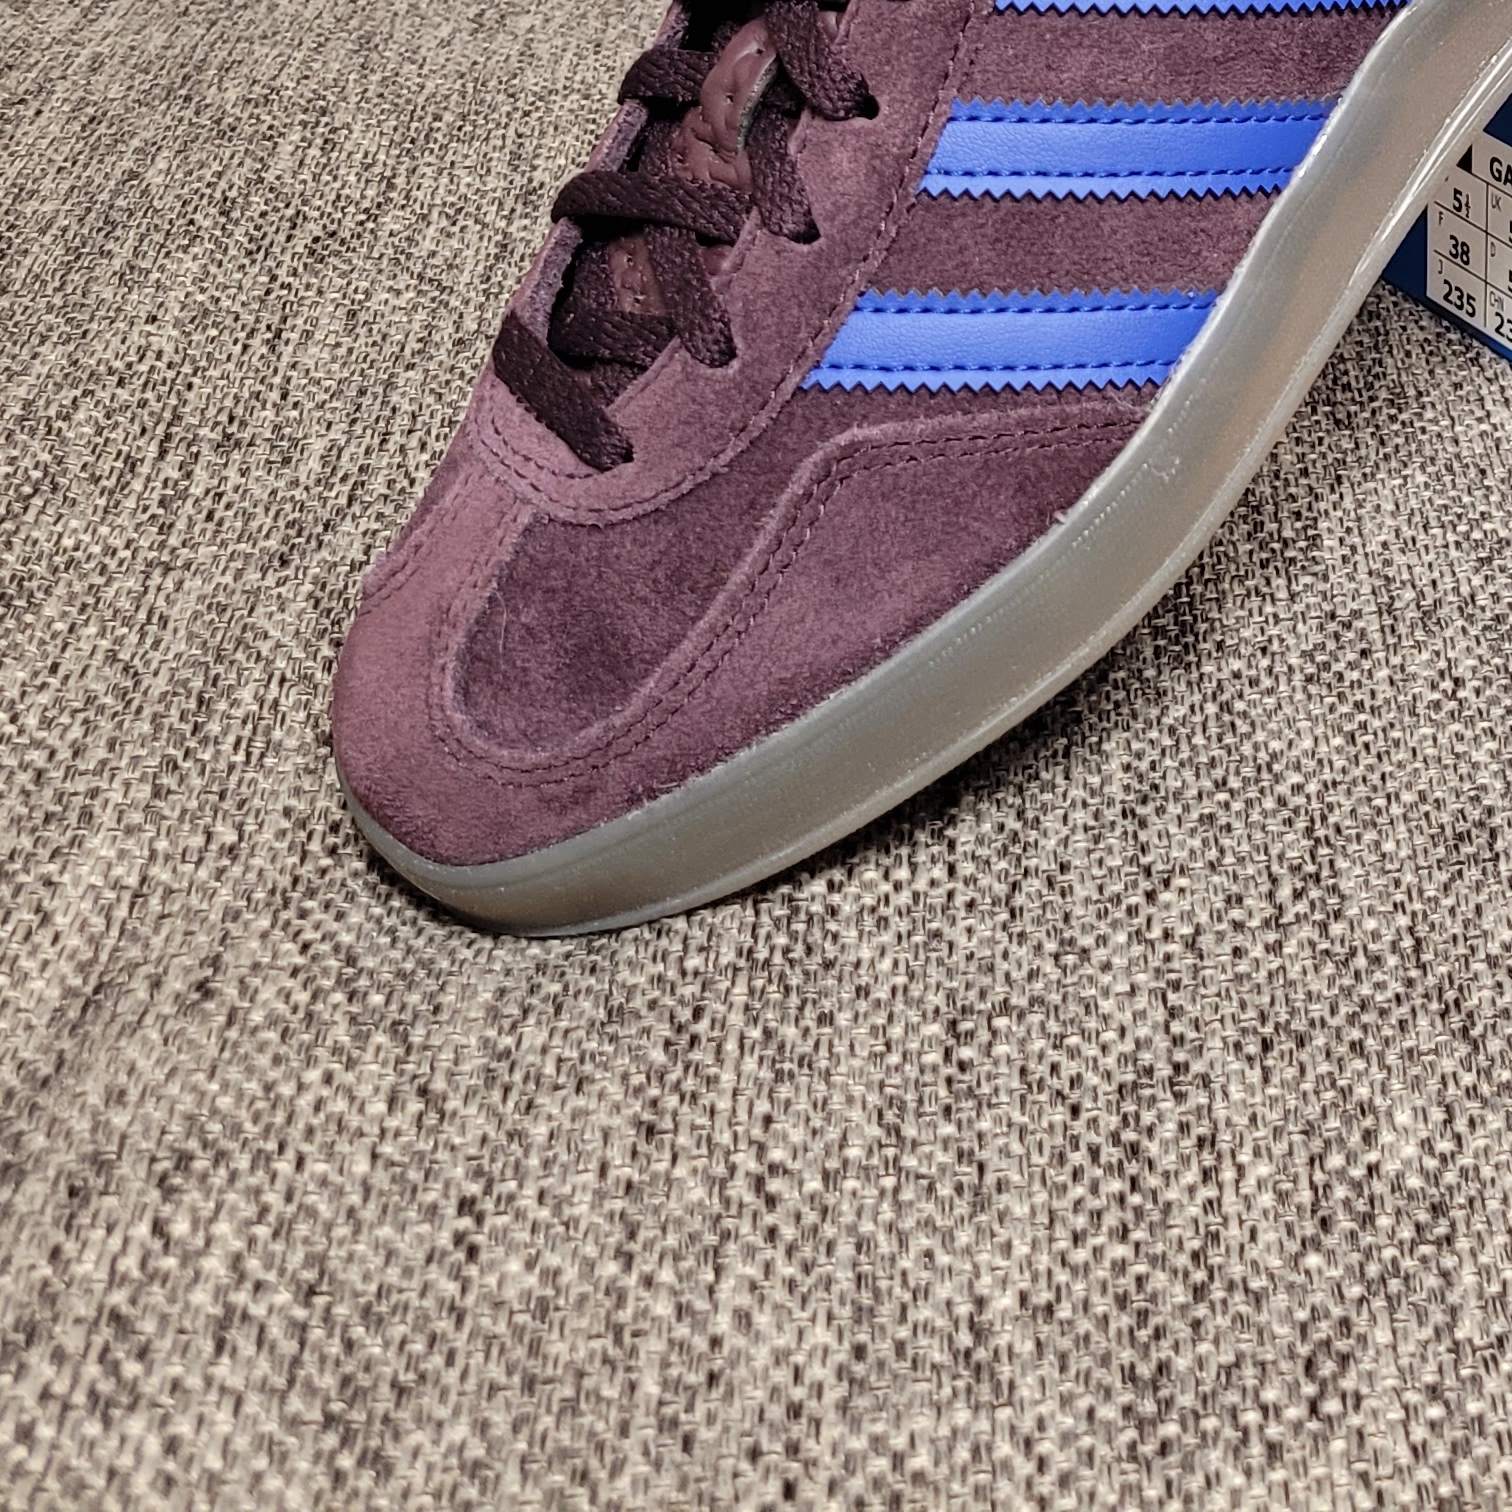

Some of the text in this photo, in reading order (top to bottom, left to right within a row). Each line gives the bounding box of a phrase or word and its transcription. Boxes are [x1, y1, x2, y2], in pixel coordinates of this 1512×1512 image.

[1438, 211, 1444, 226] F
[1448, 234, 1471, 266] 38
[1437, 259, 1443, 275] J
[1442, 278, 1477, 318] 235
